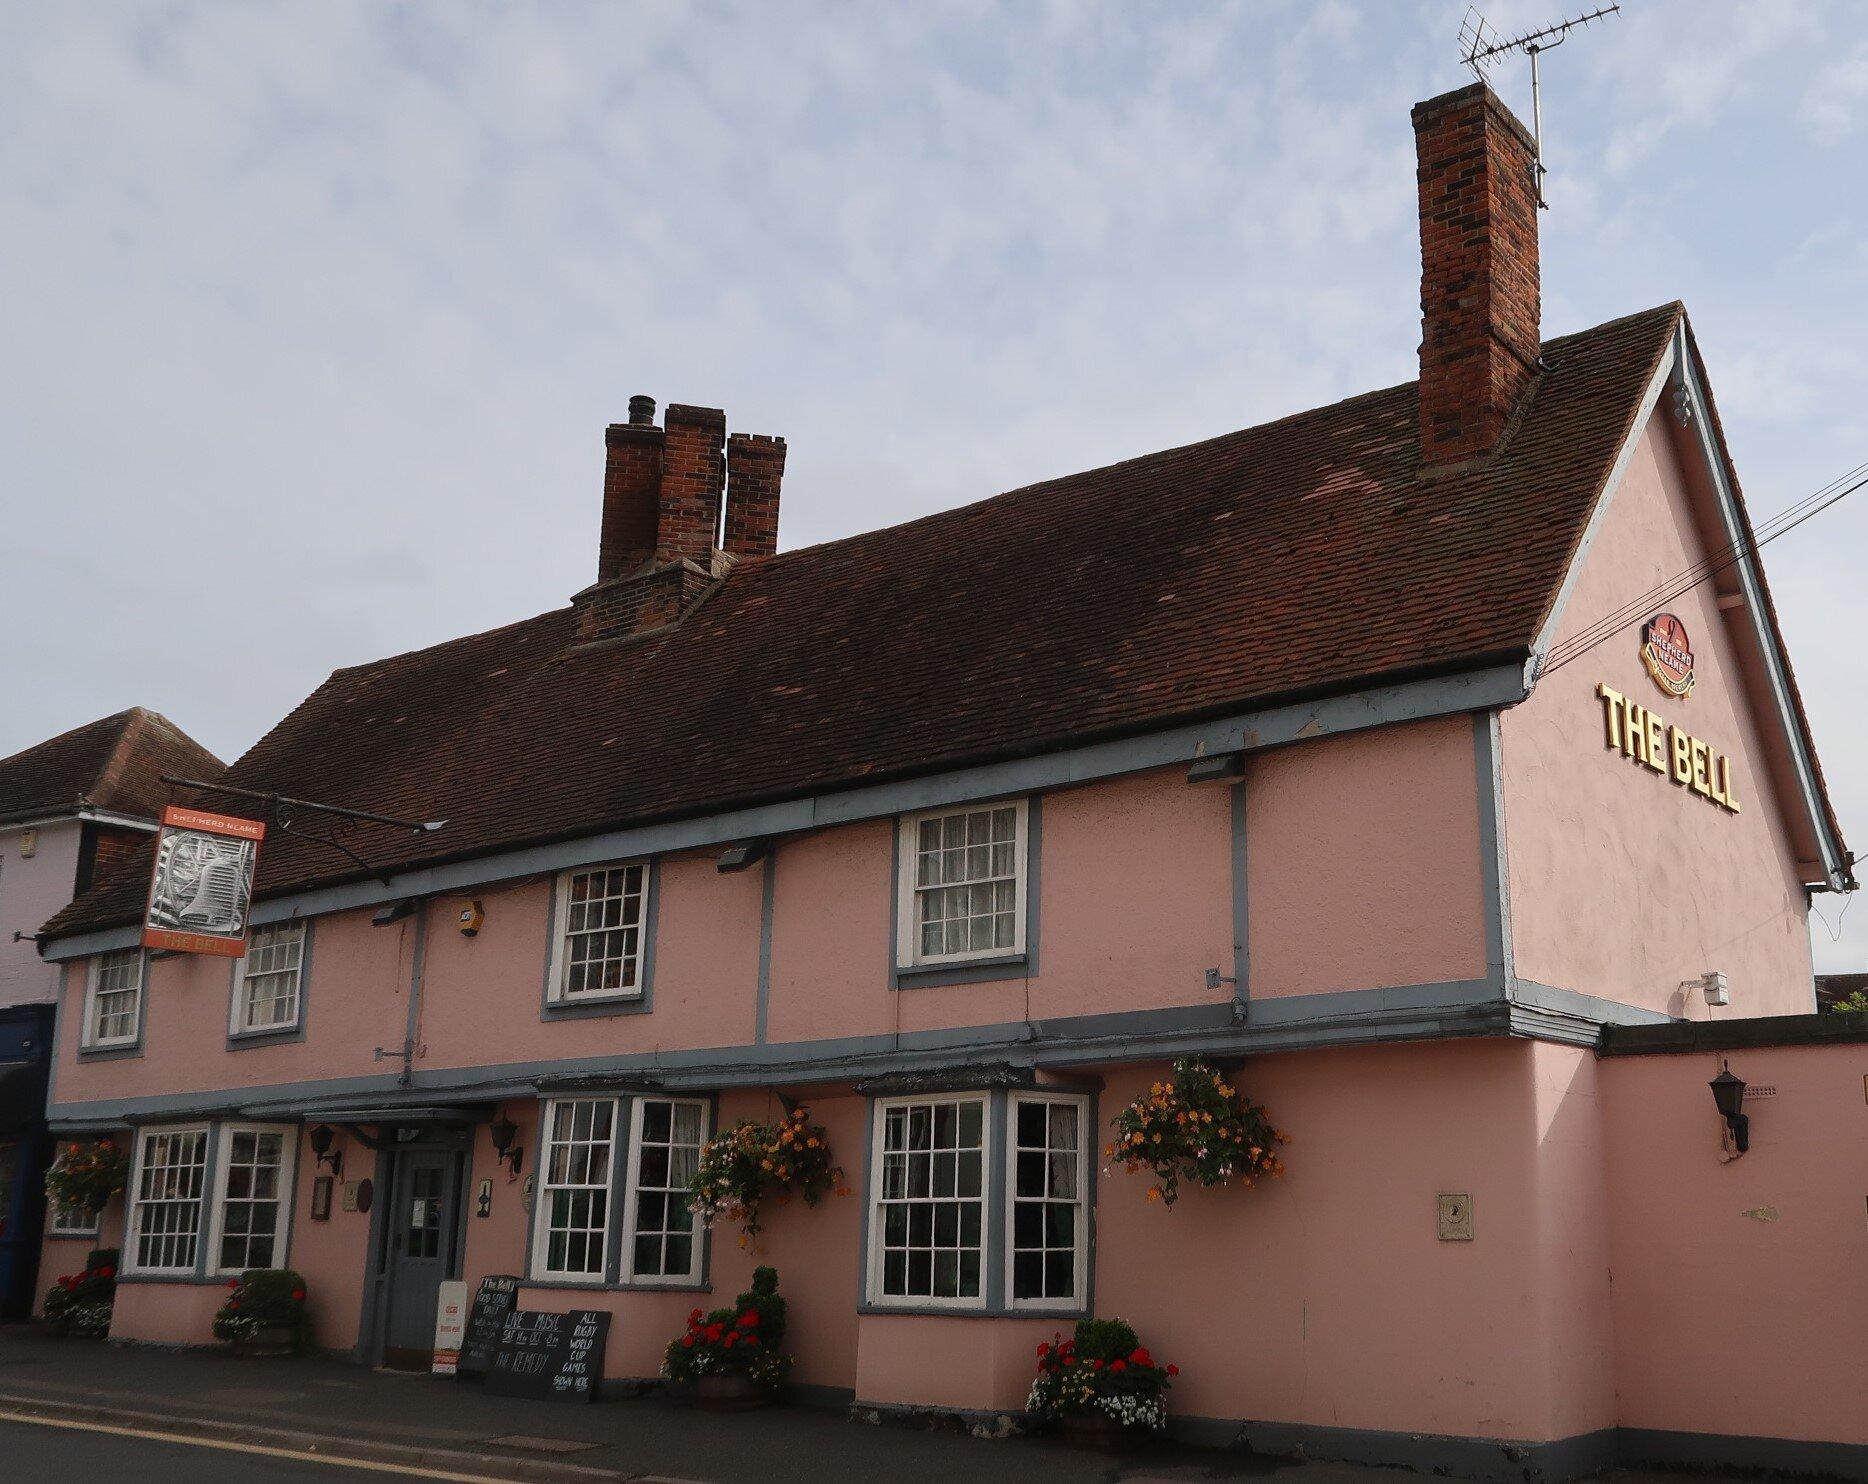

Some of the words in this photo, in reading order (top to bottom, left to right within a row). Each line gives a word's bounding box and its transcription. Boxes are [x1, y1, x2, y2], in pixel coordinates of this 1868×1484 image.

[1650, 631, 1692, 666] SHEPHERD
[1658, 649, 1684, 675] NEAME
[1599, 682, 1667, 774] THE
[1670, 724, 1742, 814] BELL
[163, 934, 190, 948] THE
[195, 938, 228, 953] BELL
[504, 1312, 525, 1329] LIVE
[534, 1313, 561, 1331] MUSIC
[580, 1312, 598, 1324] ALL
[573, 1325, 598, 1339] RUGBY
[569, 1339, 593, 1350] WORLD
[570, 1350, 587, 1361] CUP
[562, 1362, 587, 1374] GAMES
[552, 1375, 573, 1388] SHOWN
[574, 1377, 589, 1389] HERE
